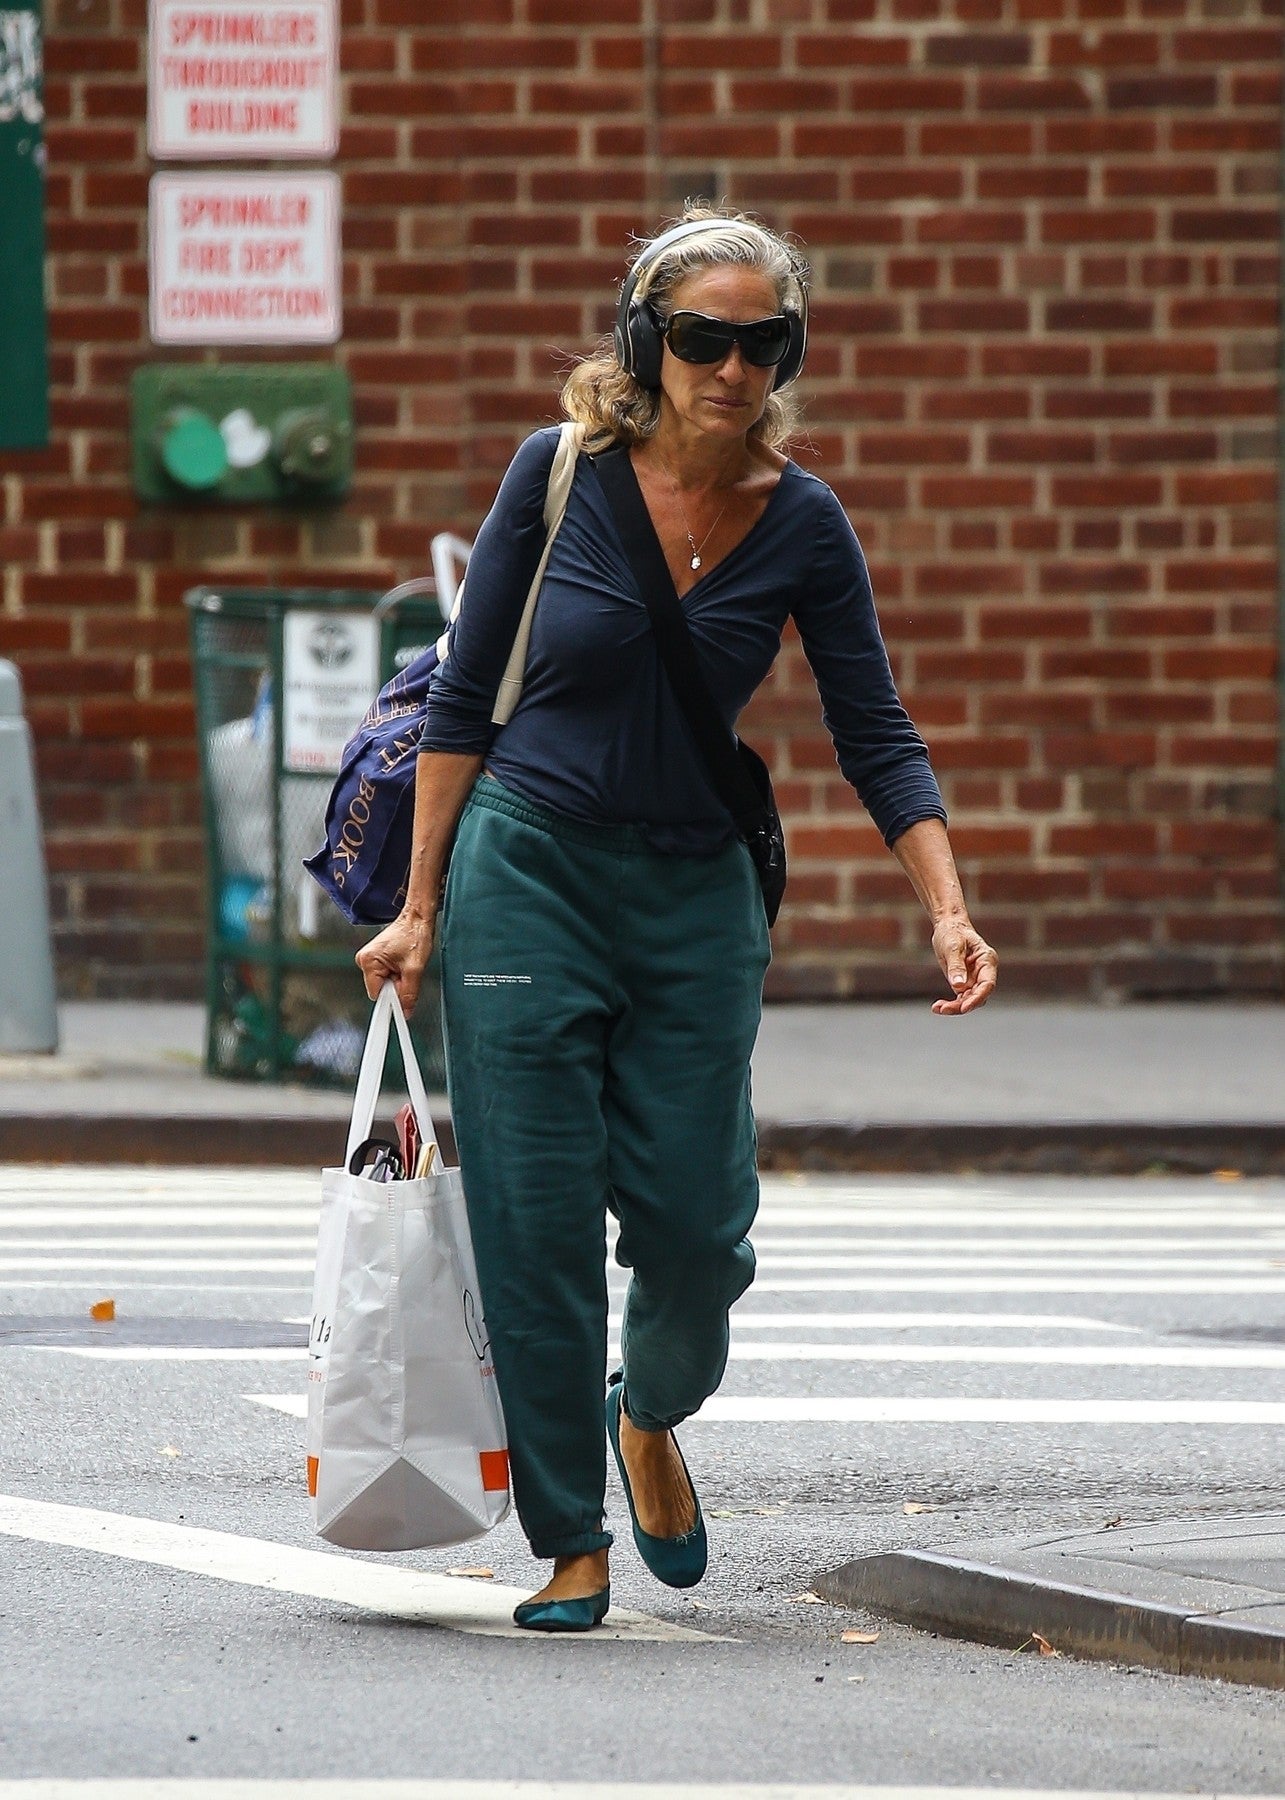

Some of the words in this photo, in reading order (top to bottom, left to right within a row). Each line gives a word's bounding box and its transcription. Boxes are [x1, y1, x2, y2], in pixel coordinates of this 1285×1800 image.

[171, 13, 317, 45] SPRINKLERS
[164, 58, 327, 88] THROUGHOUT
[188, 101, 298, 133] BUILDING
[179, 195, 311, 229] SPRINKLER
[179, 239, 232, 274] FIRE
[163, 286, 328, 320] CONNECTION
[332, 772, 377, 889] BOOKS
